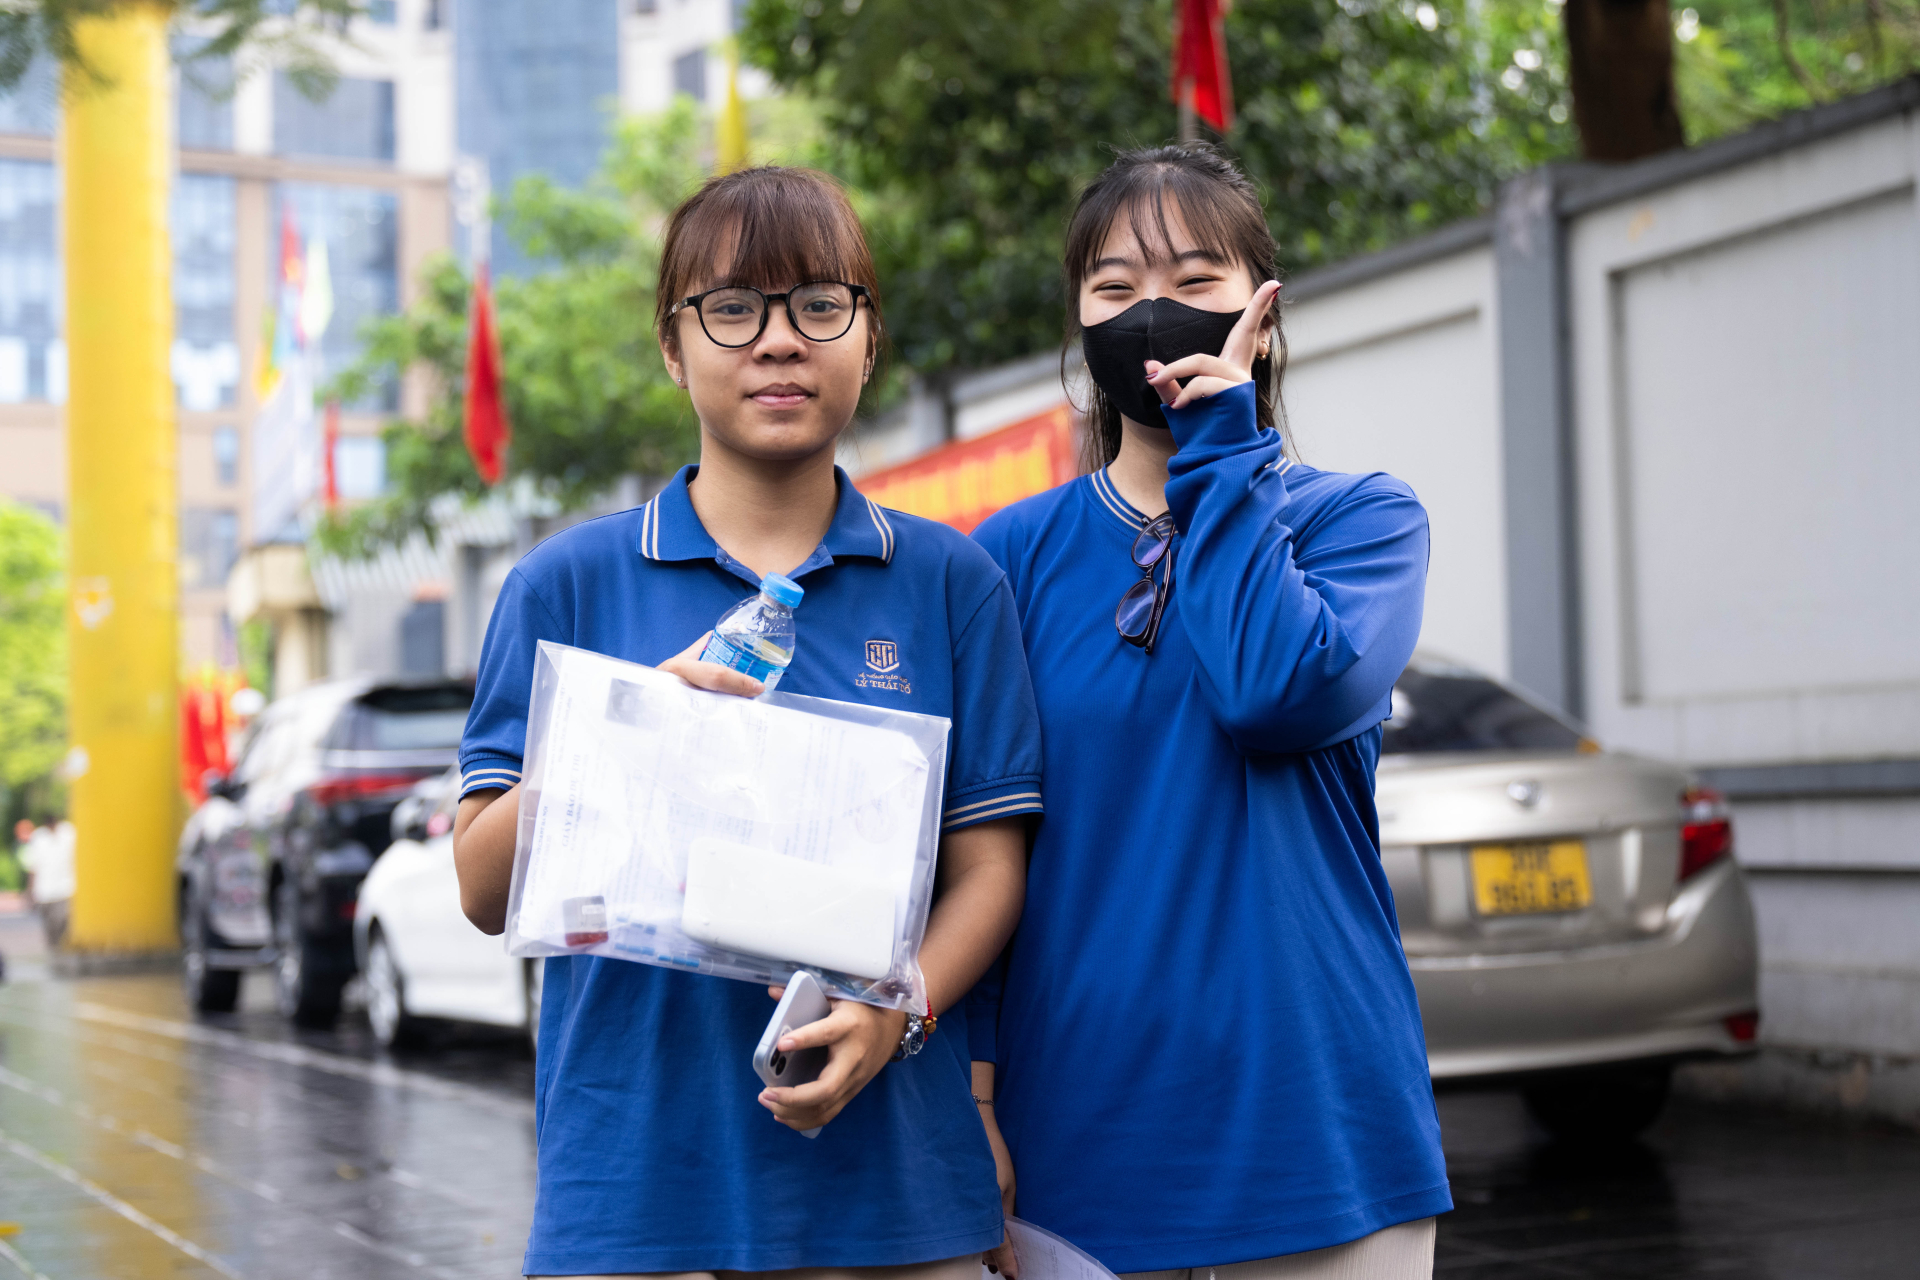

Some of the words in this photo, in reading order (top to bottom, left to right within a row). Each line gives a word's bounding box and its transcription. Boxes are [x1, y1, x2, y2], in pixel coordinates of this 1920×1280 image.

[855, 678, 868, 687] LÝ
[869, 679, 898, 691] THÁI
[899, 682, 911, 694] TỔ
[565, 793, 576, 817] BÁO
